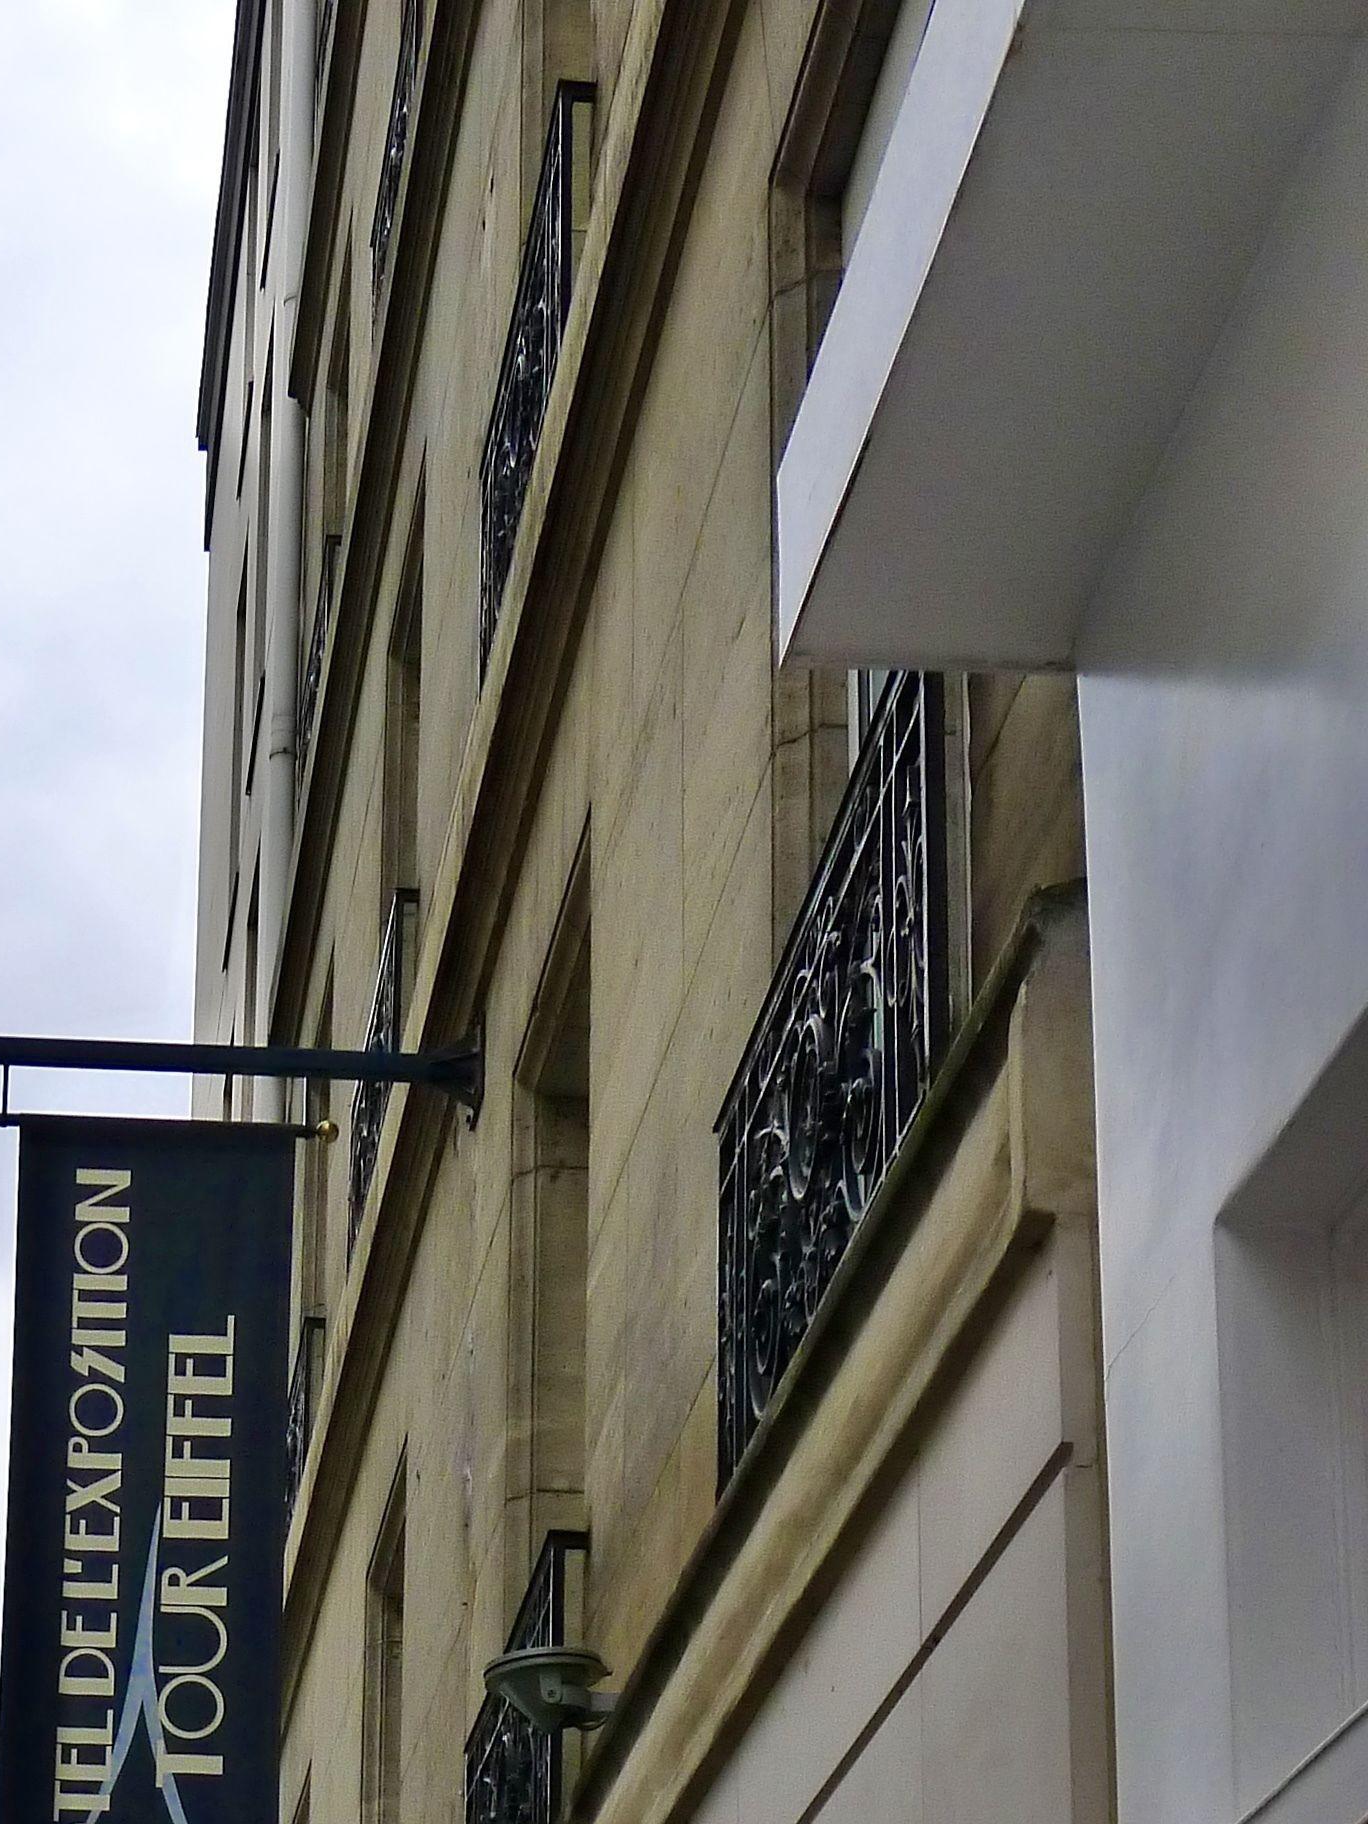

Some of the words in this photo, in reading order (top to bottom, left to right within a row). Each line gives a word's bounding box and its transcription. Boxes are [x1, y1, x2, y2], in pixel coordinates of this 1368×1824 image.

[62, 1168, 132, 1600] L'EXPOSITION
[163, 1315, 235, 1540] EIFFEL
[58, 1610, 117, 1696] DE
[156, 1556, 229, 1788] TOUR
